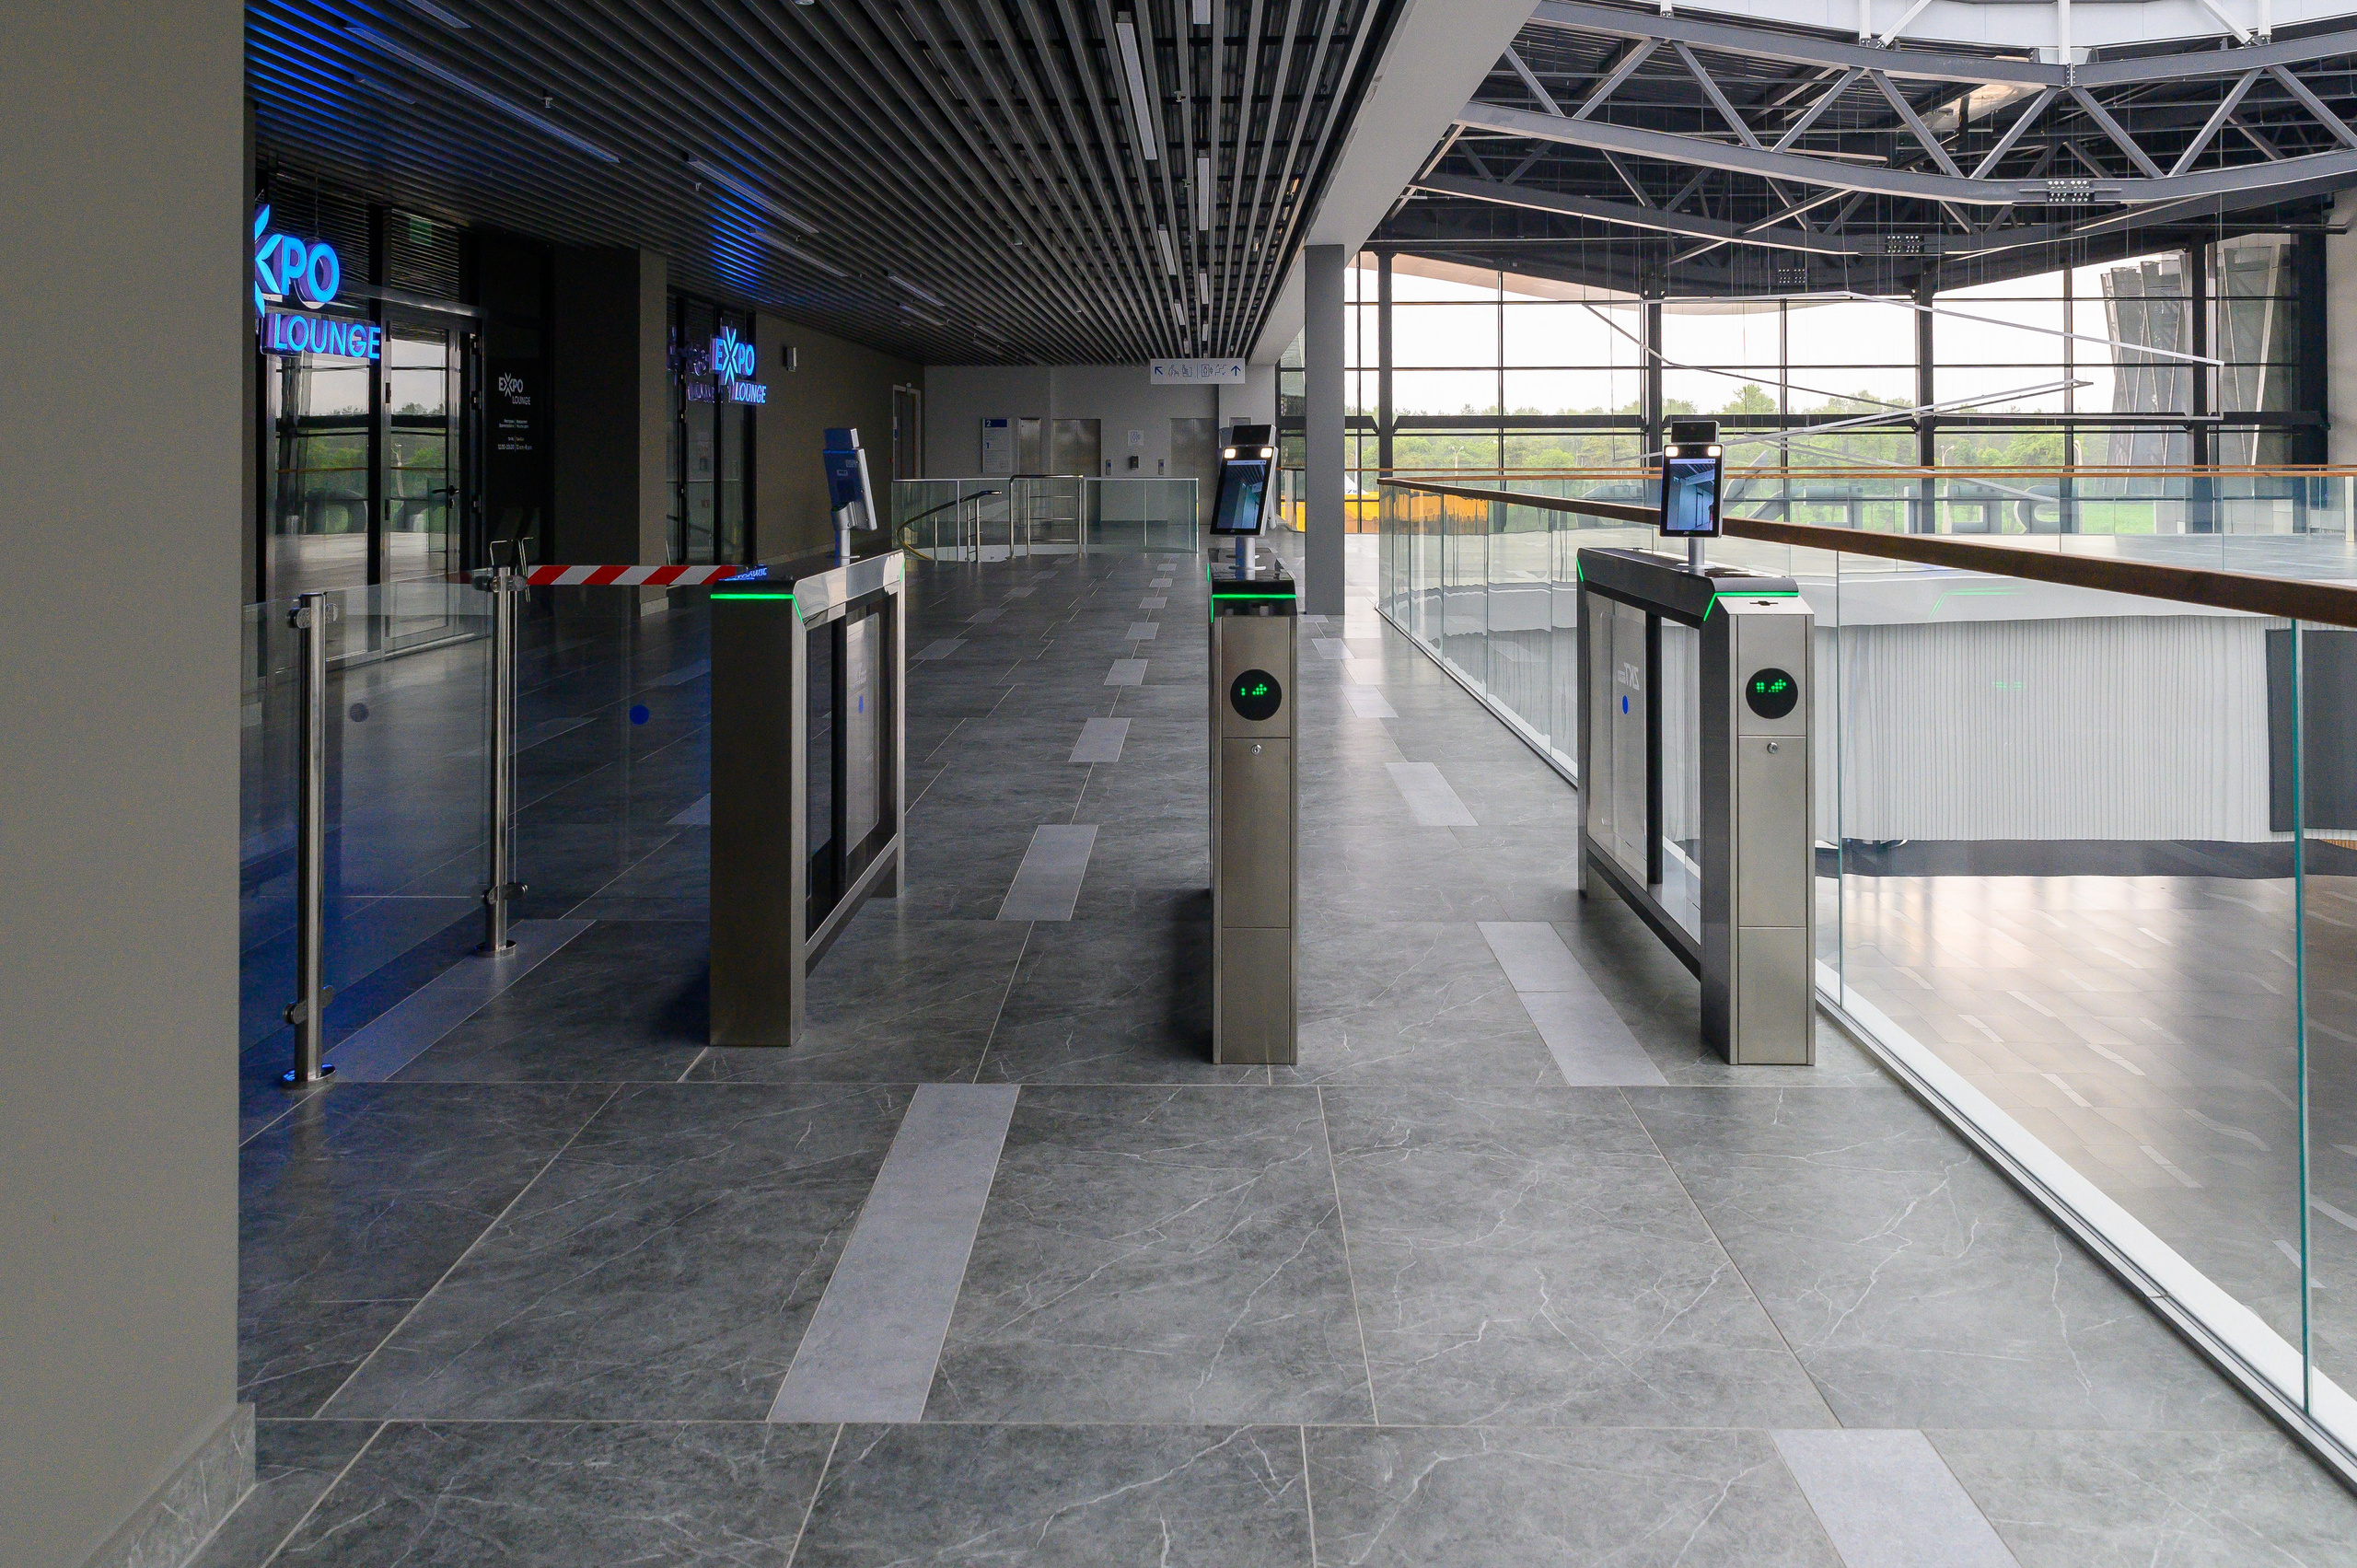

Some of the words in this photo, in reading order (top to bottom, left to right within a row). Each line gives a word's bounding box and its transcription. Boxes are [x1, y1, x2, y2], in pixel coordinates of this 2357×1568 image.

[274, 313, 381, 359] LOUNGE
[714, 326, 755, 386] EXPO
[498, 372, 524, 397] EXPO
[734, 381, 767, 403] LOUNGE
[512, 396, 531, 406] LOUNGE
